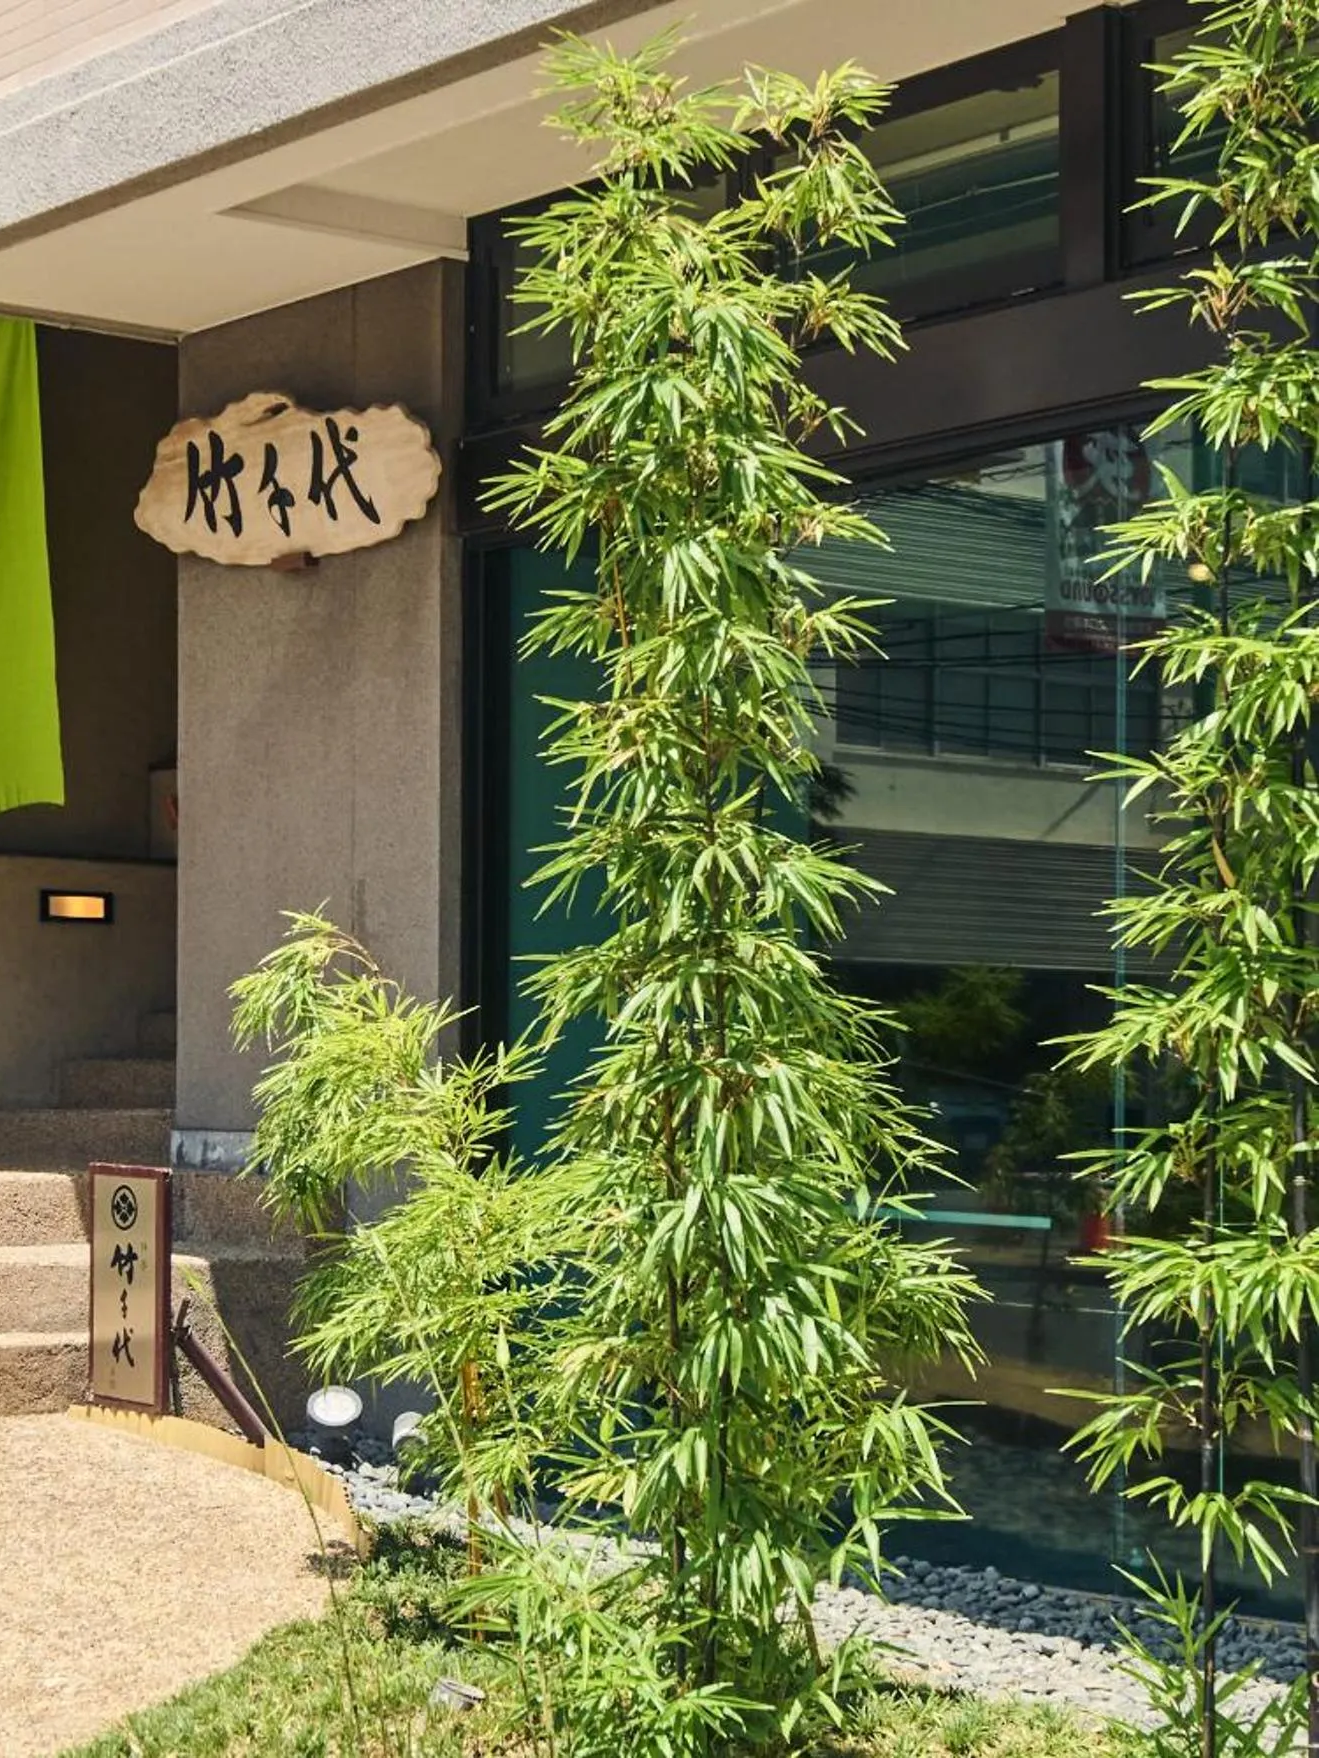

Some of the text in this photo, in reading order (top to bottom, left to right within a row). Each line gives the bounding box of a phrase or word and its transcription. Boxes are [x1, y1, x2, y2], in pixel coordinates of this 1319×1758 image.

[184, 416, 381, 538] 竹千代
[111, 1242, 138, 1368] 竹千代
